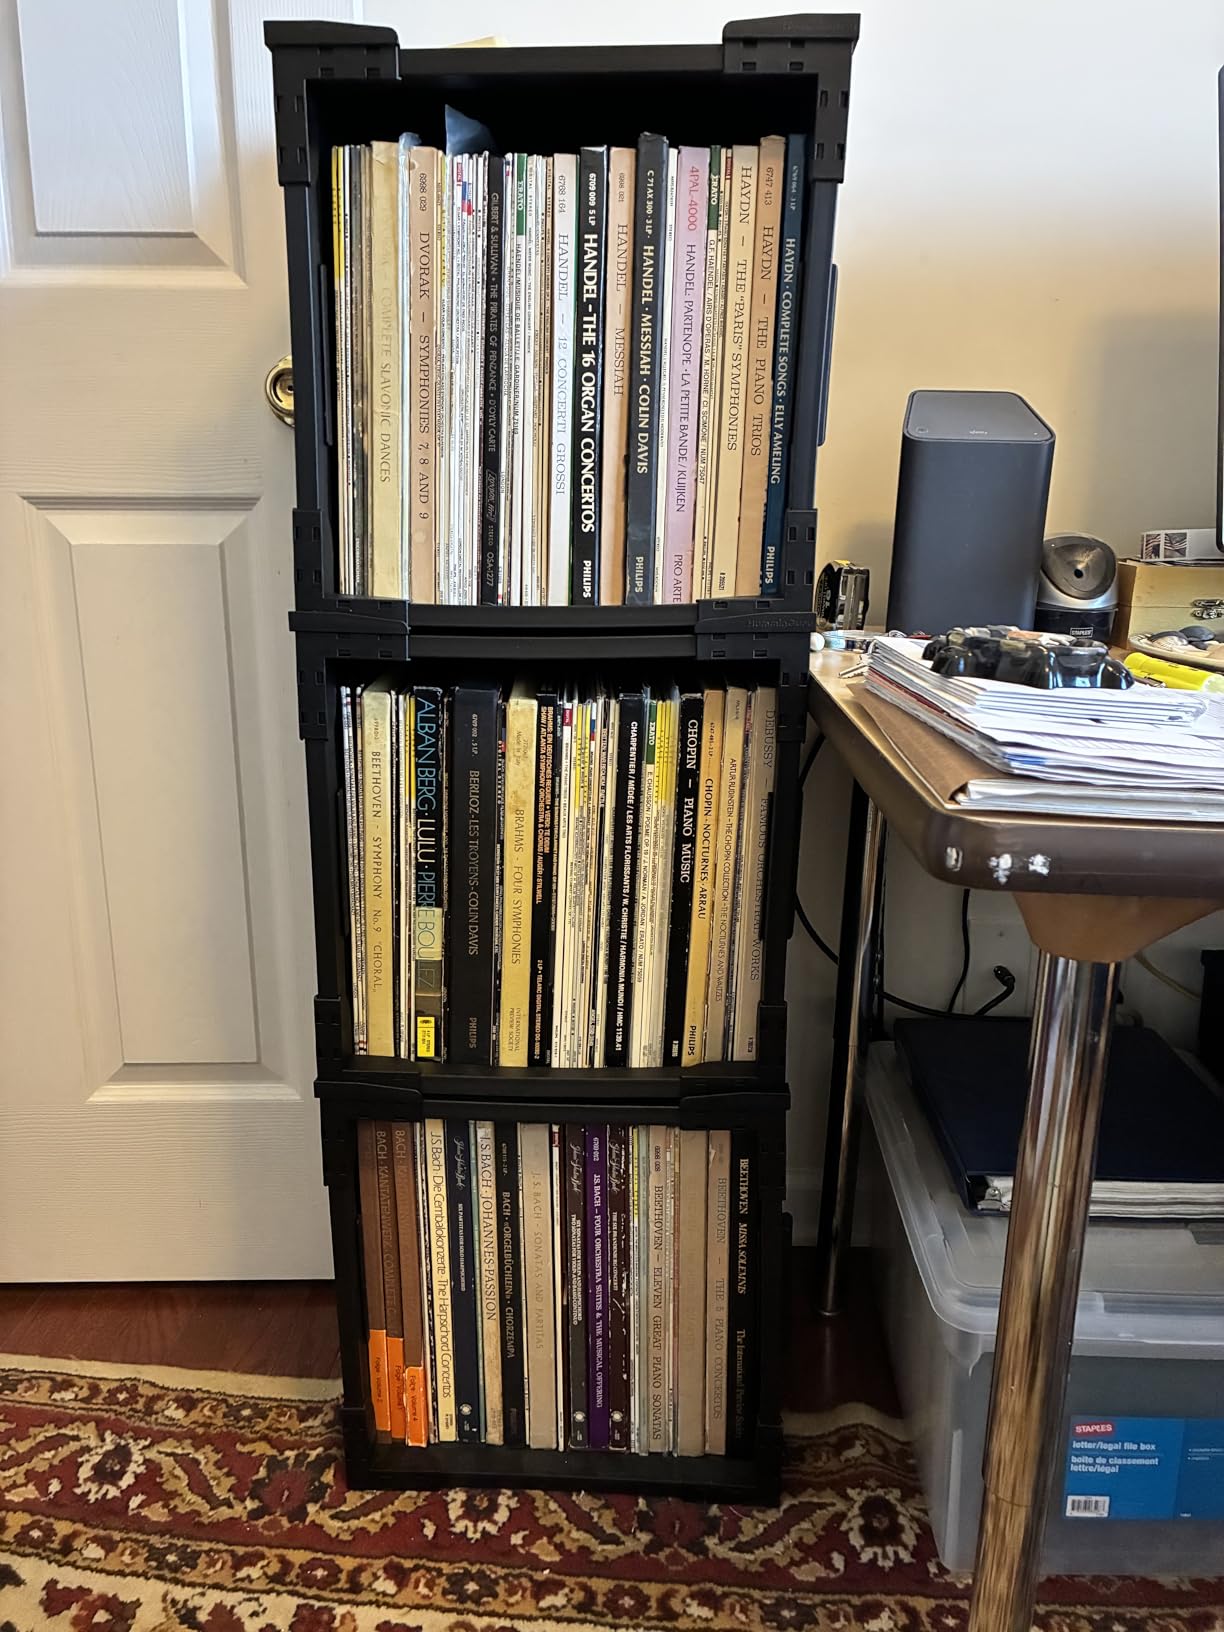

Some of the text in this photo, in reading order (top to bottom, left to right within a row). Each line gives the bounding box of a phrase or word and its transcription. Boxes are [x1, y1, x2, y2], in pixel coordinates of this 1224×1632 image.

[558, 175, 566, 195] 6768
[589, 216, 595, 225] LP
[420, 232, 429, 299] DVORAK
[558, 234, 568, 300] HANDEL
[641, 246, 654, 304] HANDEL
[614, 224, 627, 396] HANDEL MESSIAH
[727, 167, 752, 450] HAYDN THE SYMPHONIES
[751, 167, 773, 456] 6747 413 HAYDN THE PIANO TRIOS
[558, 336, 567, 349] 12
[583, 350, 595, 367] 16
[640, 314, 652, 374] MESSIAH
[419, 335, 429, 434] SYMPHONIES
[486, 193, 499, 586] GILBERT SULLIVAN THE PIRATES OF PENZANCE CARTE OSA-1277
[557, 359, 567, 433] CONCERTI
[581, 372, 595, 432] ORGAN
[638, 385, 650, 428] COLIN
[673, 166, 699, 602] 4PAL-4000 PARTENOPE PETITE KUIJKEN PRO ARTE
[765, 238, 795, 584] HAYDN COMPLETE SONGS ELLY AMELING PHILIPS
[380, 363, 391, 482] SLAVONIC DANCES
[556, 443, 566, 495] GROSSI
[637, 433, 649, 473] DAVIS
[419, 473, 429, 503] AND
[581, 438, 595, 532] CONCERTOS
[583, 560, 591, 598] PHILIPS
[635, 557, 644, 592] PHILIPS
[628, 722, 638, 774] CHARPENTIER
[372, 752, 381, 818] BEETHOVEN
[680, 720, 698, 883] CHOPIN PIANO MUSIC
[373, 837, 382, 898] SYMPHONY
[417, 697, 435, 988] ALBAN BERG LULU PIERRE BOULEZ
[623, 846, 632, 893] FLORISSANTS
[751, 710, 775, 980] DEBUSSY WORKS
[511, 809, 524, 964] BRAHMS FOUR SYMPHONIES
[622, 898, 629, 906] W.
[373, 910, 381, 925] No.
[620, 908, 628, 939] CHRISTIE
[687, 778, 714, 1056] CHOPIN NOCTURNES ARRAU PHILIPS
[468, 925, 478, 1048] DAVIS PHILIPS
[618, 945, 627, 983] HARMONIA
[717, 960, 725, 974] AND
[616, 1012, 624, 1027] HMC
[617, 984, 625, 1006] MUNDI
[376, 1131, 387, 1159] BACH
[395, 1130, 406, 1158] BACH
[480, 1154, 496, 1321] BACH JOHANNES-PASSION
[738, 1159, 749, 1295] BEETHOVEN MISSA SOLEMNIS
[433, 1176, 452, 1398] Die Cembalokonzerte The Harpsichord Concertos
[653, 1185, 663, 1440] BEETHOVEN ELEVEN GREAT PIANO SONATAS
[714, 1178, 727, 1420] BEETHOVEN THE PIANO CONCERTOS
[505, 1307, 514, 1358] CHORZEMPA
[536, 1308, 545, 1349] PARTITAS
[1075, 1424, 1112, 1433] STAPLES
[1123, 1441, 1138, 1450] file
[1095, 1456, 1107, 1464] de
[1108, 1456, 1159, 1465] classement
